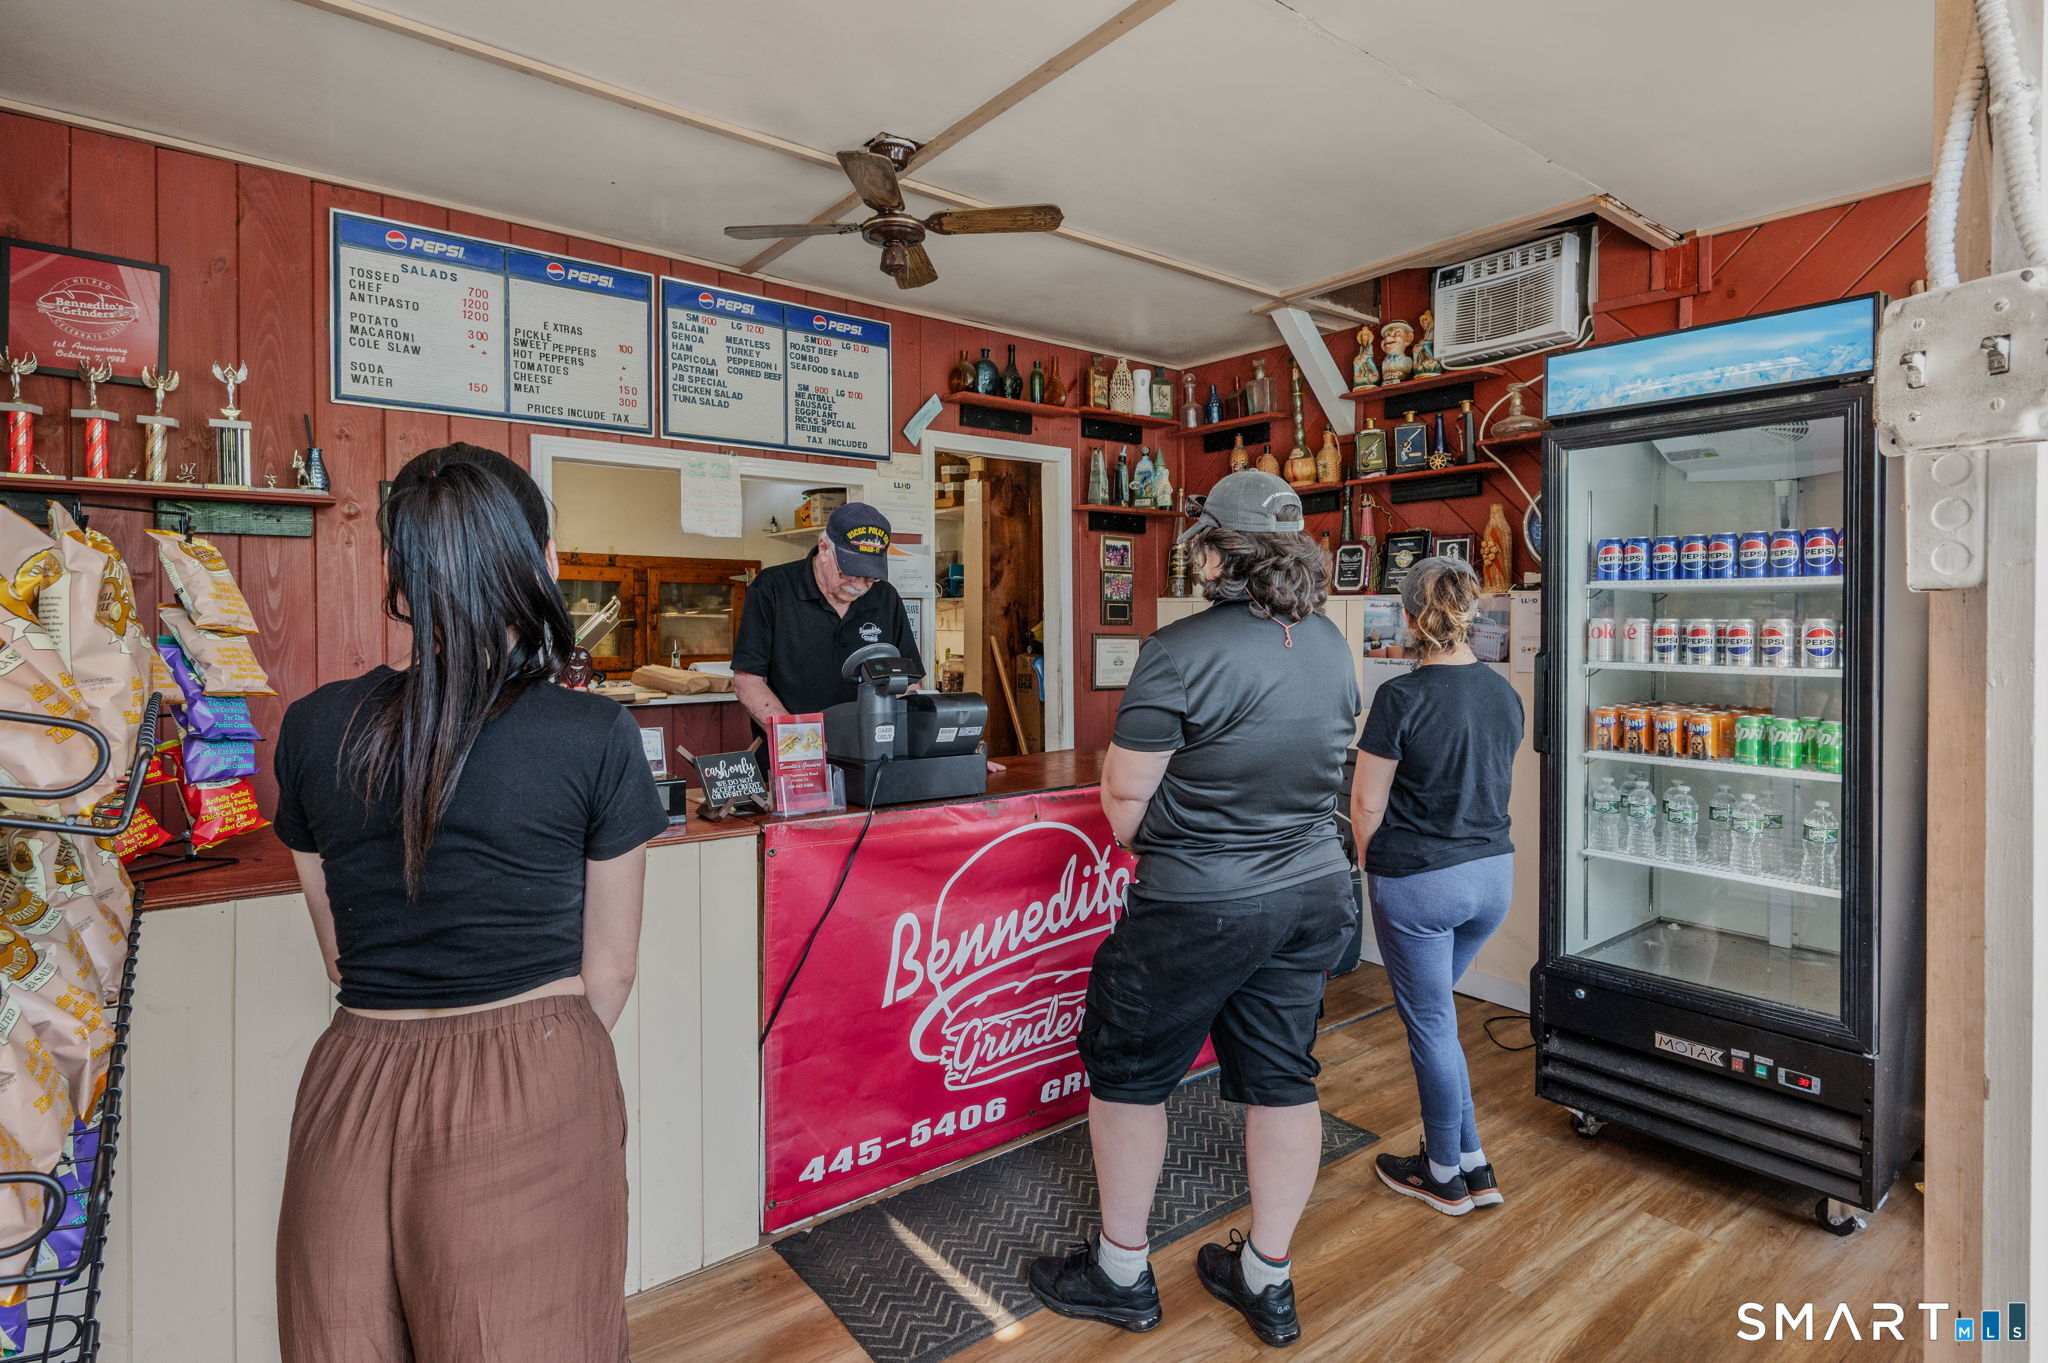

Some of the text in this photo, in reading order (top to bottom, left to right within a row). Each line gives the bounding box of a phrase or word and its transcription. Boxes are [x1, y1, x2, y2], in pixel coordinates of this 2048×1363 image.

[410, 237, 464, 259] PEPSI
[350, 266, 400, 283] TOSSED
[401, 264, 458, 282] SALADS
[567, 269, 614, 288] PEPSI
[73, 278, 112, 290] HELPED
[349, 279, 382, 293] CHEF
[468, 287, 489, 299] 700
[55, 297, 125, 311] Bennedito's
[350, 292, 420, 311] ANTIPASTO
[462, 298, 489, 310] 1200
[716, 298, 755, 315] PEPSI
[61, 308, 115, 318] Grinders
[350, 312, 398, 328] POTATO
[462, 310, 489, 322] 1200
[672, 321, 709, 334] SALAMI
[686, 313, 764, 334] SM 900 LG 1200
[828, 320, 863, 336] PEPSI
[350, 324, 415, 342] MACARONI
[515, 328, 552, 342] PICKLE
[672, 332, 704, 344] GENOA
[72, 342, 128, 355] Anniversary
[349, 337, 421, 355] COLE SLAW
[514, 338, 596, 358] SWEET PEPPERS
[619, 344, 633, 354] 100
[672, 342, 693, 352] HAM
[726, 336, 770, 350] MEATLESS
[790, 342, 838, 357] ROAST BEEF
[842, 342, 851, 350] LG
[56, 350, 90, 361] October
[514, 349, 584, 366] HOT PEPPERS
[671, 352, 716, 366] CAPICOLA
[726, 346, 761, 358] TURKEY
[790, 352, 820, 363] COMBO
[350, 361, 384, 375] SODA
[514, 360, 569, 375] TOMATOES
[672, 363, 719, 376] PASTRAMI
[727, 366, 782, 381] CORNED BEEF
[790, 362, 859, 379] SEAFOOD SALAD
[351, 374, 393, 387] WATER
[514, 372, 553, 384] CHEESE
[673, 374, 727, 388] JB SPECIAL
[468, 382, 488, 393] 150
[514, 384, 541, 394] MEAT
[619, 386, 637, 396] 150
[672, 384, 743, 400] CHICKEN SALAD
[798, 384, 809, 392] SM
[814, 386, 829, 394] 900
[836, 389, 845, 397] LG
[619, 398, 637, 407] 300
[673, 394, 729, 408] TUNA SALAD
[795, 391, 836, 404] MEATBALL
[795, 400, 833, 411] SAUSAGE
[527, 404, 629, 423] PRICES INCLUDE TAX
[795, 408, 837, 419] EGGPLANT
[795, 415, 818, 425] RICKS
[796, 424, 827, 434] REUBEN
[807, 436, 868, 449] TAX INCLUDED
[705, 757, 756, 779] cash only
[712, 782, 760, 794] ACCEPT CREDIT
[723, 790, 742, 799] DEBIT
[118, 846, 138, 857] erfect
[7, 904, 38, 923] POTATO
[881, 844, 1131, 1009] Bennedito
[0, 1008, 16, 1032] LTED
[953, 994, 1086, 1084] Grinder
[1659, 1036, 1721, 1063] MOTAK
[799, 1096, 1007, 1184] 445-5406
